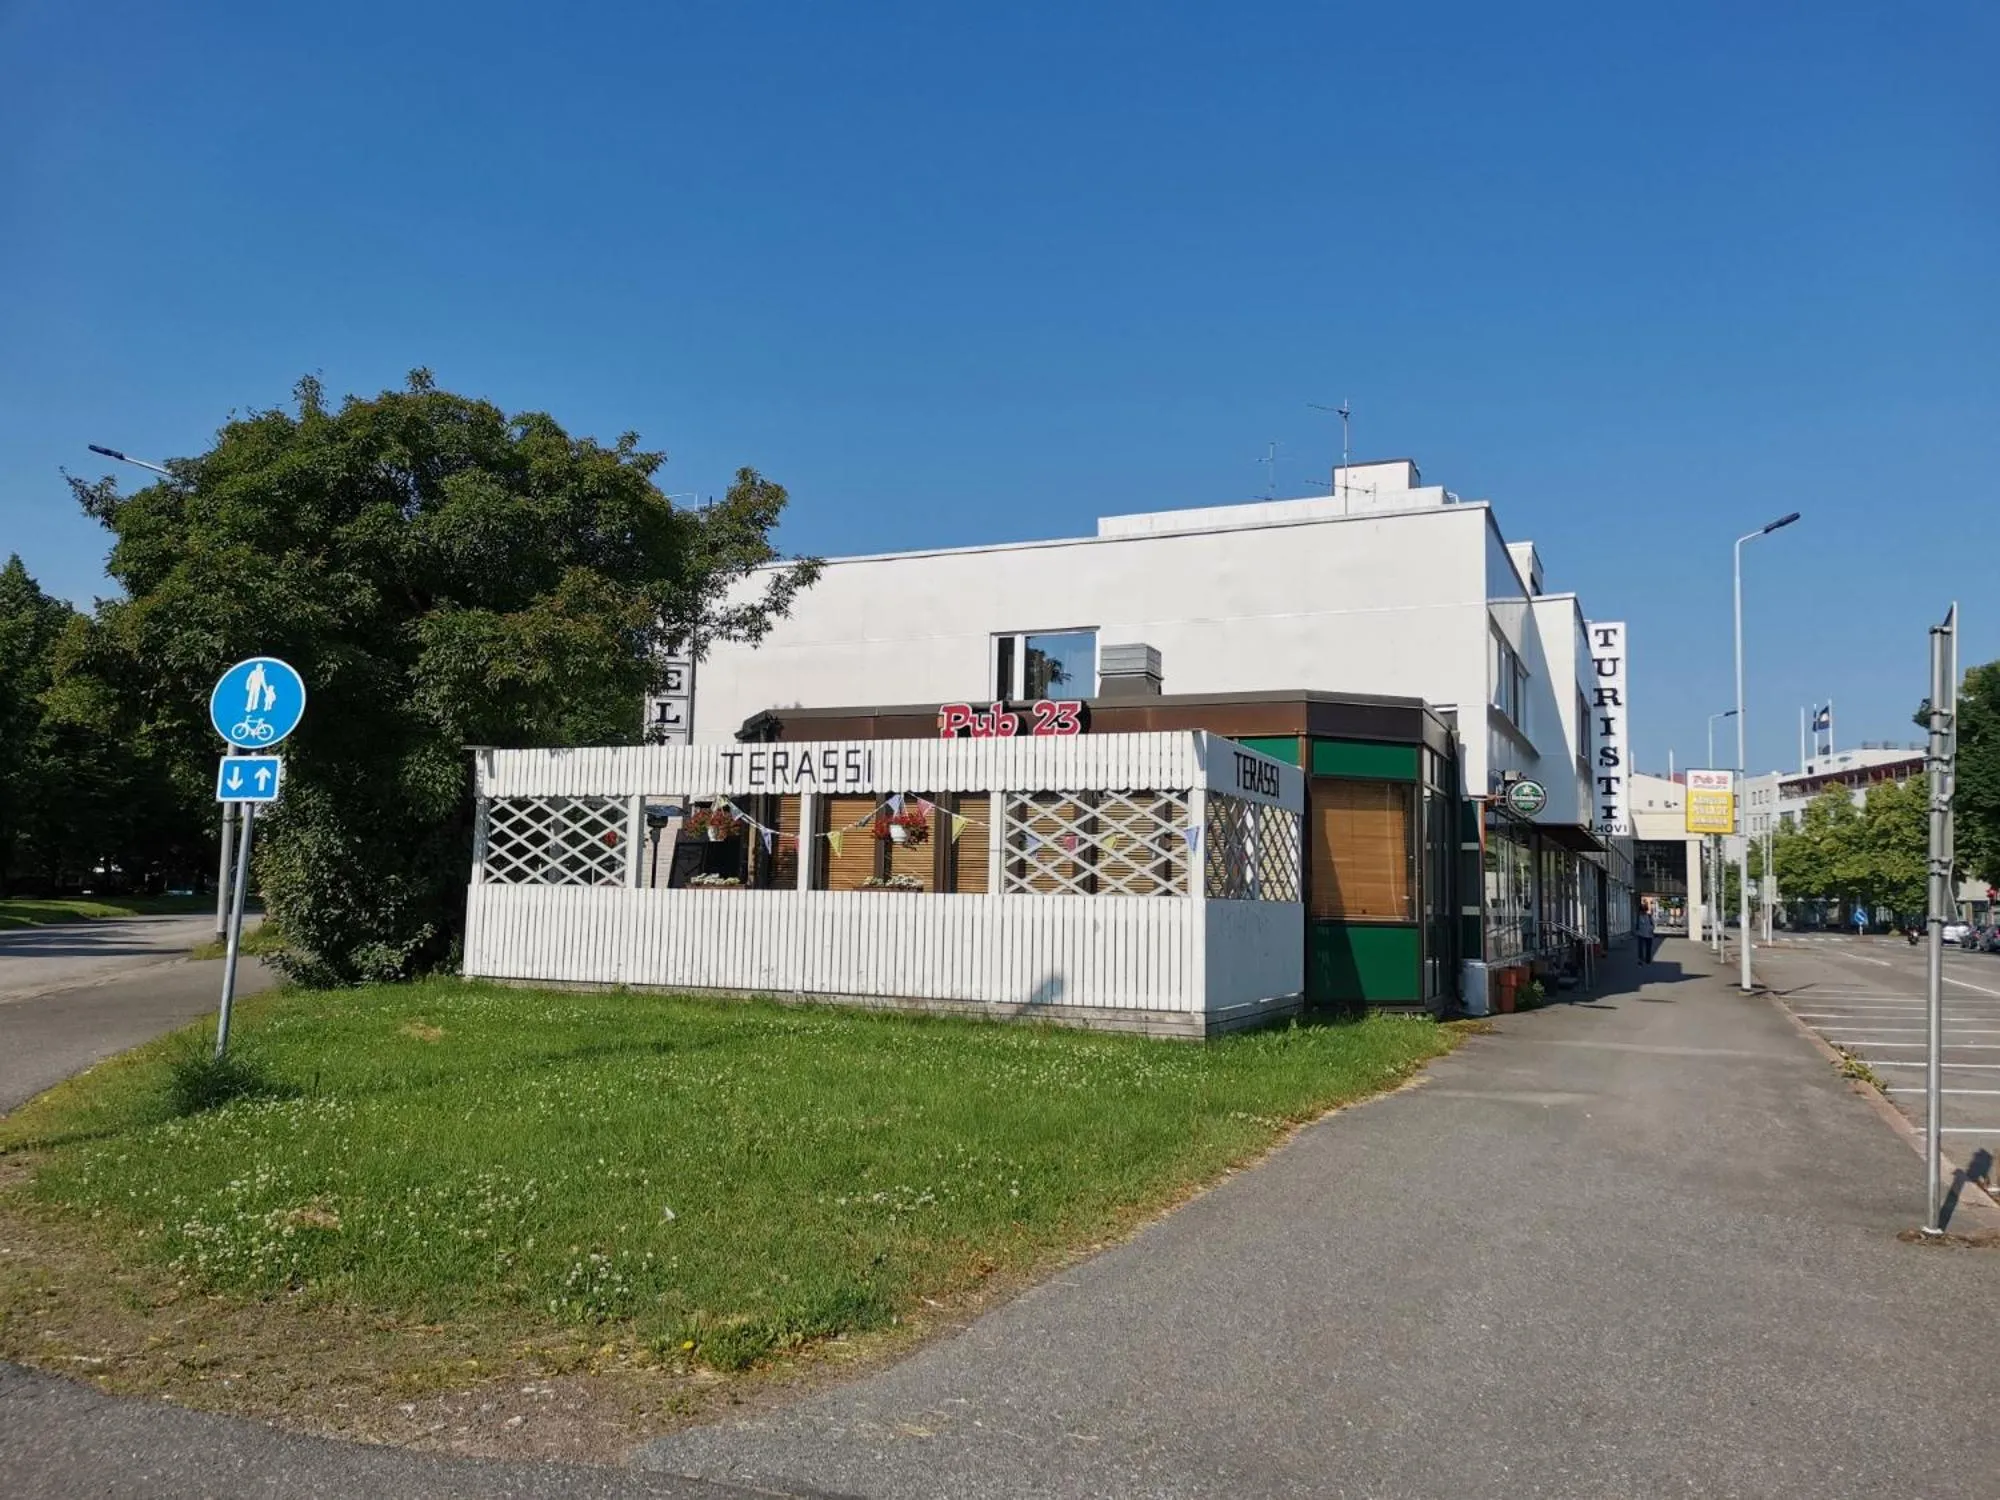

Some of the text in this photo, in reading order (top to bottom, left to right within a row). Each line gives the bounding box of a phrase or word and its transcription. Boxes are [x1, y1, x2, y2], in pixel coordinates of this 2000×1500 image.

[939, 700, 1082, 738] Pub 23
[1592, 628, 1622, 819] TURISTI
[721, 750, 872, 785] TERASSI
[1233, 751, 1280, 799] TERASSI
